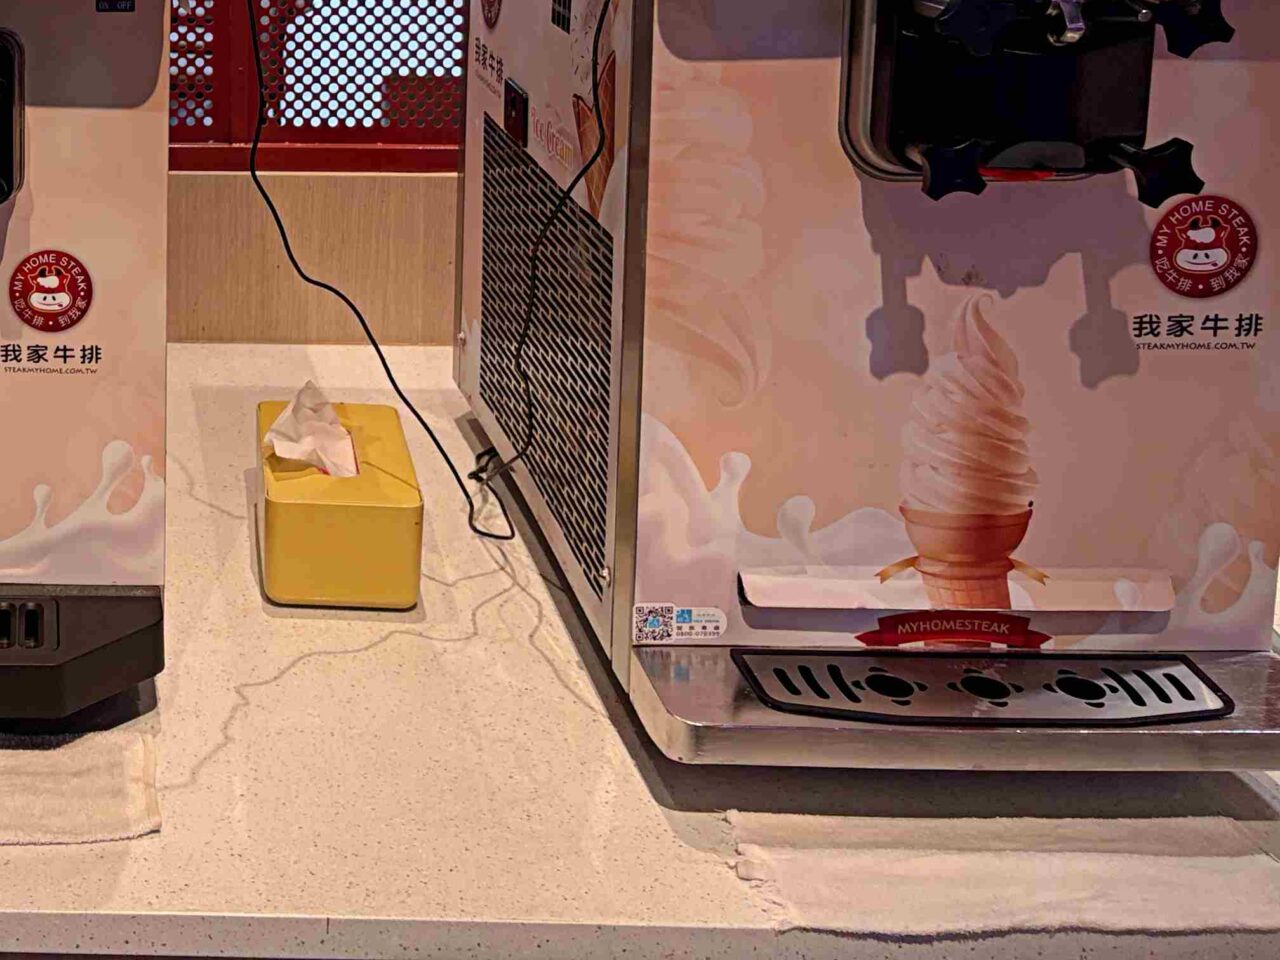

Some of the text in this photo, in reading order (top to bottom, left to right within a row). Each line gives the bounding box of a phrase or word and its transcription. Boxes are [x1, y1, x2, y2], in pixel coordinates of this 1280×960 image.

[1155, 200, 1250, 247] MY HOME STEAK
[13, 253, 87, 291] MY HOME STEAK
[1155, 253, 1250, 292] 吃牛排 到我家
[1133, 313, 1264, 338] 我家牛排
[0, 344, 102, 364] 我家牛排
[1136, 342, 1255, 350] STEAKMYHOME.COM.TW
[897, 619, 1010, 635] MYHOMESTEAK
